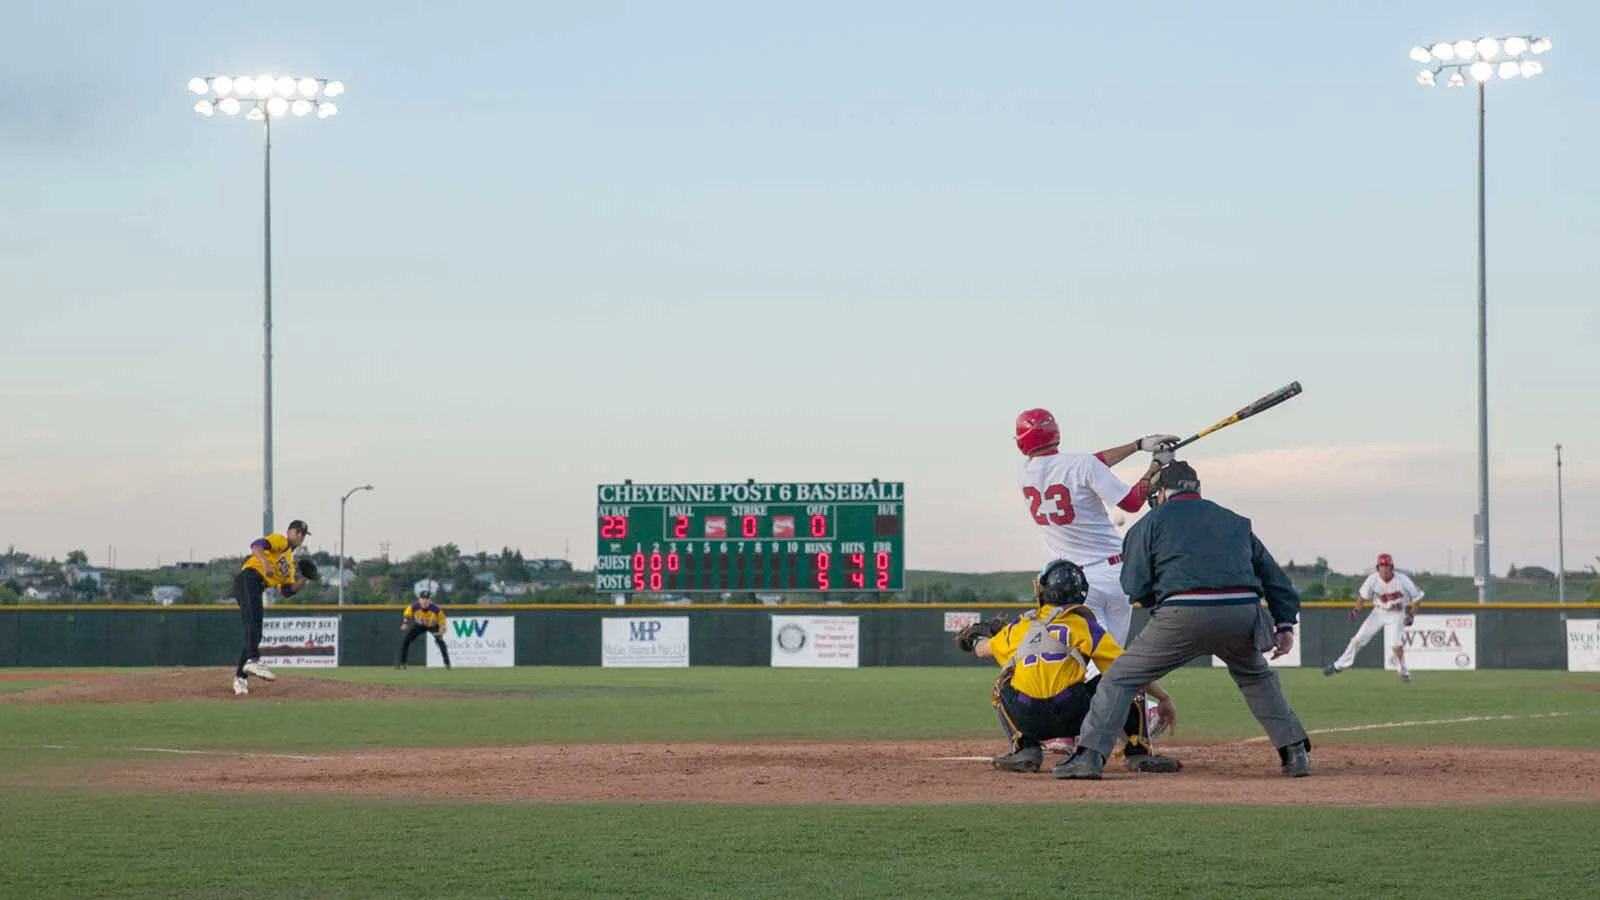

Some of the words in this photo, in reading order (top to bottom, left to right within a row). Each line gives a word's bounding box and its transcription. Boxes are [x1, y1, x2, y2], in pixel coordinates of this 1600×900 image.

[600, 485, 716, 502] CHEYENNE
[720, 485, 775, 502] POST
[780, 485, 792, 501] 6
[797, 483, 904, 501] BASEBALL
[598, 505, 609, 517] AT
[611, 505, 631, 517] BAT
[669, 505, 695, 517] BALL
[731, 504, 768, 516] STRIKE
[806, 504, 829, 516] OUT
[1023, 483, 1076, 526] 23
[600, 515, 628, 538] 23
[674, 515, 689, 538] 2
[743, 514, 758, 538] 0
[811, 514, 826, 538] 0
[636, 543, 641, 553] 1
[652, 542, 660, 553] 2
[668, 542, 677, 553] 3
[686, 542, 693, 553] 4
[703, 542, 711, 553] 5
[720, 542, 727, 553] 6
[737, 542, 744, 553] 7
[754, 542, 762, 553] 8
[771, 542, 779, 553] 9
[787, 542, 799, 553] 10
[804, 542, 832, 553] RUNS
[841, 542, 865, 553] HITS
[873, 542, 891, 553] ERR
[597, 555, 631, 570] GUEST
[633, 553, 646, 571] 0
[650, 553, 663, 571] 0
[666, 553, 679, 571] 0
[817, 552, 830, 570] 0
[851, 553, 864, 569] 4
[876, 552, 889, 570] 0
[597, 573, 622, 589] POST
[624, 573, 632, 589] 6
[633, 573, 645, 590] 5
[650, 572, 663, 590] 0
[817, 571, 830, 590] 5
[851, 572, 864, 589] 4
[876, 571, 889, 590] 2
[263, 621, 279, 629] WER
[282, 621, 293, 629] UP
[295, 621, 316, 629] POST
[452, 619, 489, 638] WV
[629, 620, 662, 642] MHP
[263, 634, 305, 645] heyenne
[308, 633, 336, 644] Light
[1023, 624, 1068, 668] 0
[1569, 631, 1600, 642] WOO
